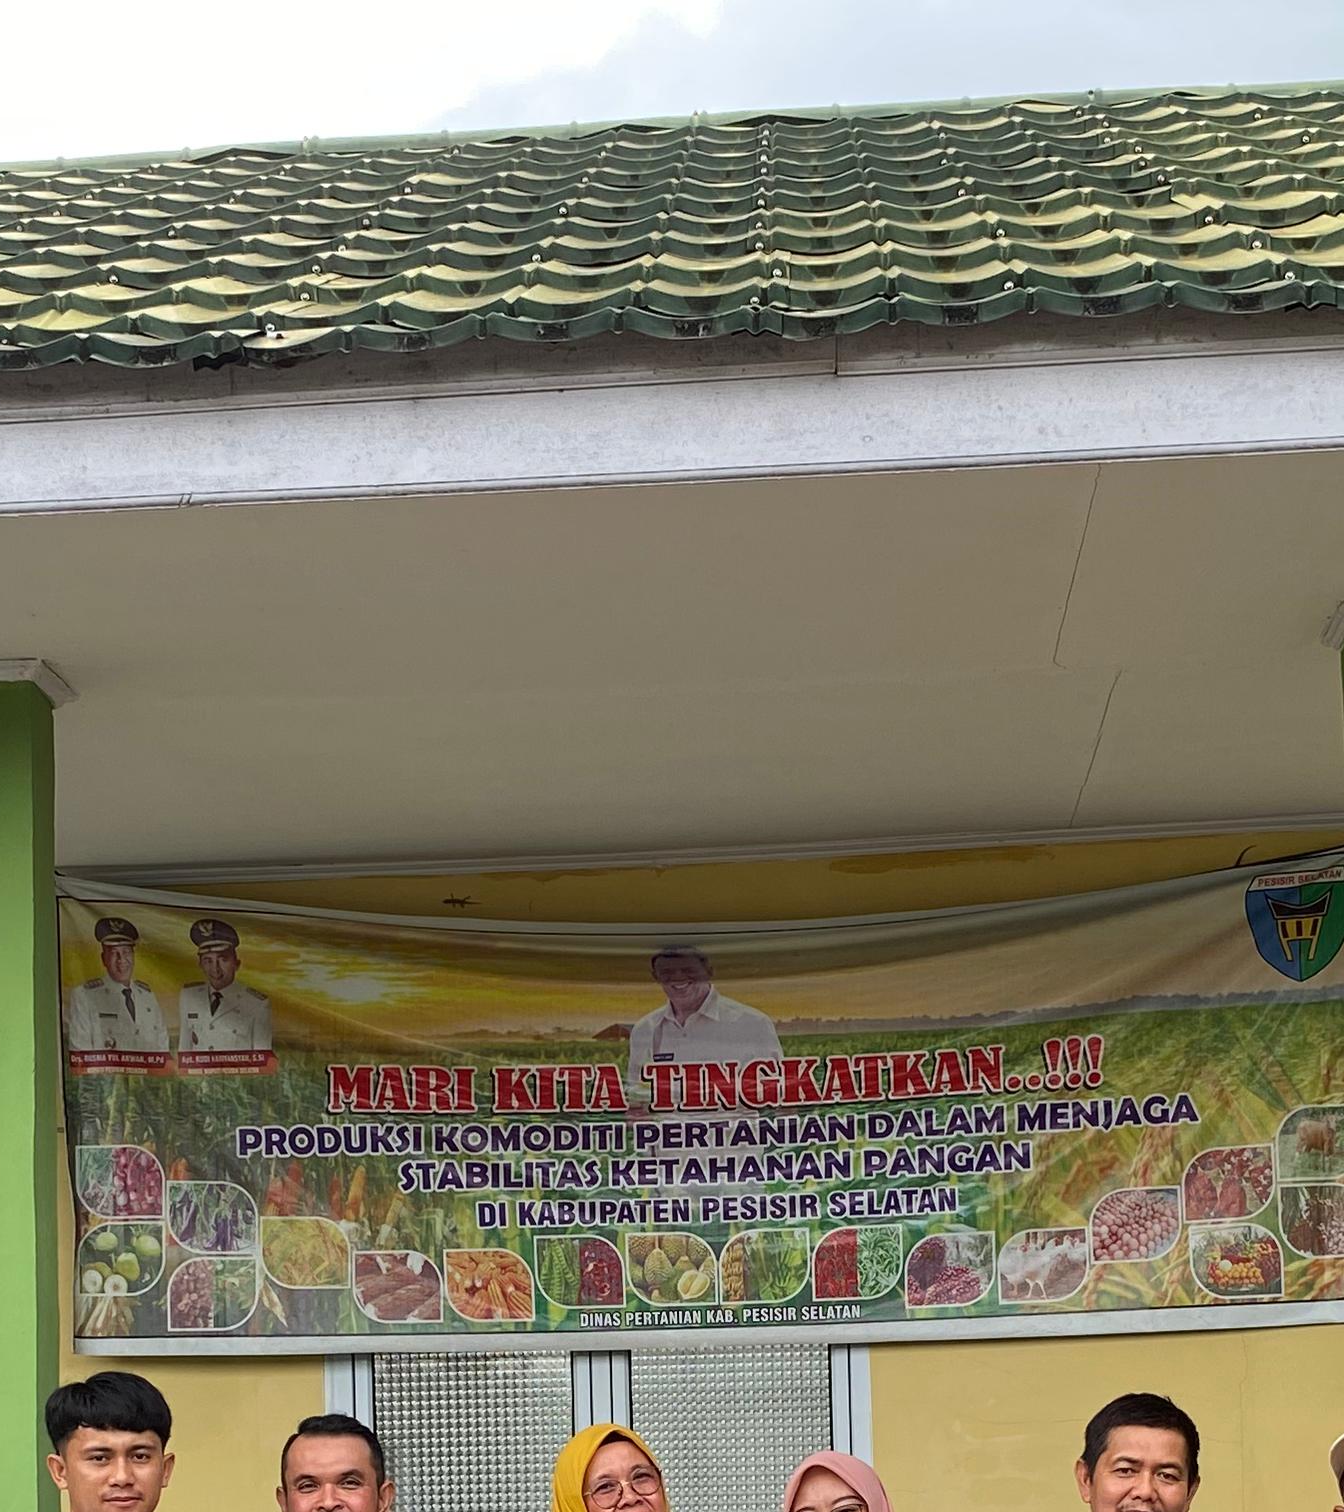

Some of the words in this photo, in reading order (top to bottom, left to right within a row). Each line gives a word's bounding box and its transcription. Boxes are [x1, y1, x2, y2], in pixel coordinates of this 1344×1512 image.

[326, 1064, 478, 1114] MARI
[492, 1064, 628, 1114] KITA
[238, 1125, 423, 1159] PRODUKSI
[434, 1122, 625, 1155] KOMODITI
[635, 1113, 856, 1151] PERTANIAN
[867, 1104, 1006, 1141] DALAM
[1017, 1093, 1199, 1134] MENJAGA
[399, 1158, 602, 1193] STABILITAS
[610, 1147, 852, 1189] KETAHANAN
[862, 1140, 1034, 1179] PANGAN
[476, 1200, 508, 1229] DI
[518, 1198, 691, 1228] KABUPATEN
[701, 1193, 819, 1223] PESISIR
[829, 1186, 959, 1219] SELATAN
[579, 1312, 621, 1328] DINAS
[625, 1309, 702, 1327] PERTANIAN
[706, 1308, 739, 1325] KAB.
[743, 1306, 797, 1323] PESISIR
[801, 1304, 862, 1321] SELATAN
